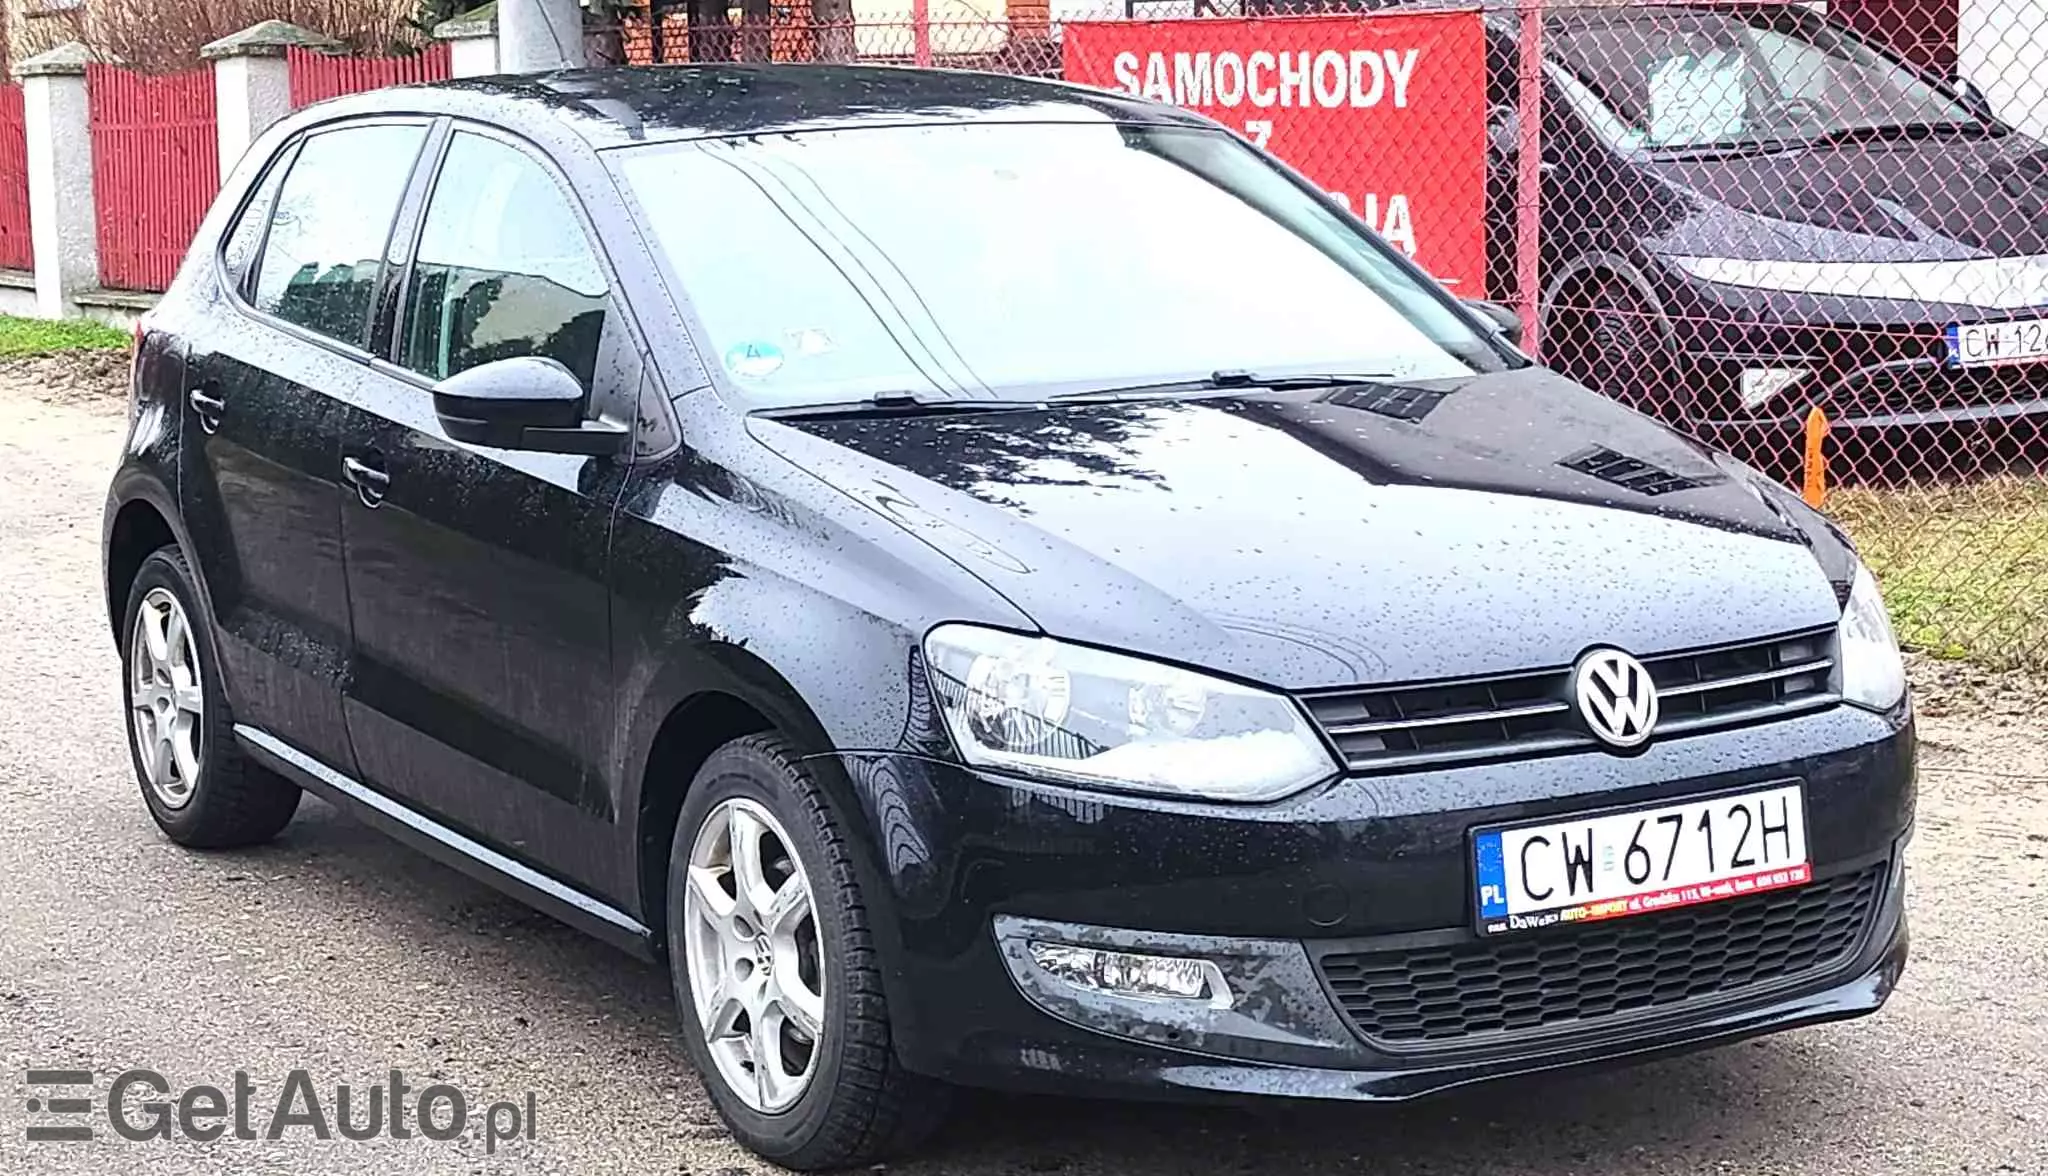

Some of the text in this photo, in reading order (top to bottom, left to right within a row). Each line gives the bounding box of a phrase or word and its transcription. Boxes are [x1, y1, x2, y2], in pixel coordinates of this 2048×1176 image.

[1113, 48, 1420, 109] SAMOCHODY
[2014, 323, 2048, 354] 12
[1520, 796, 1791, 901] CW 6712H
[1480, 884, 1505, 906] PL
